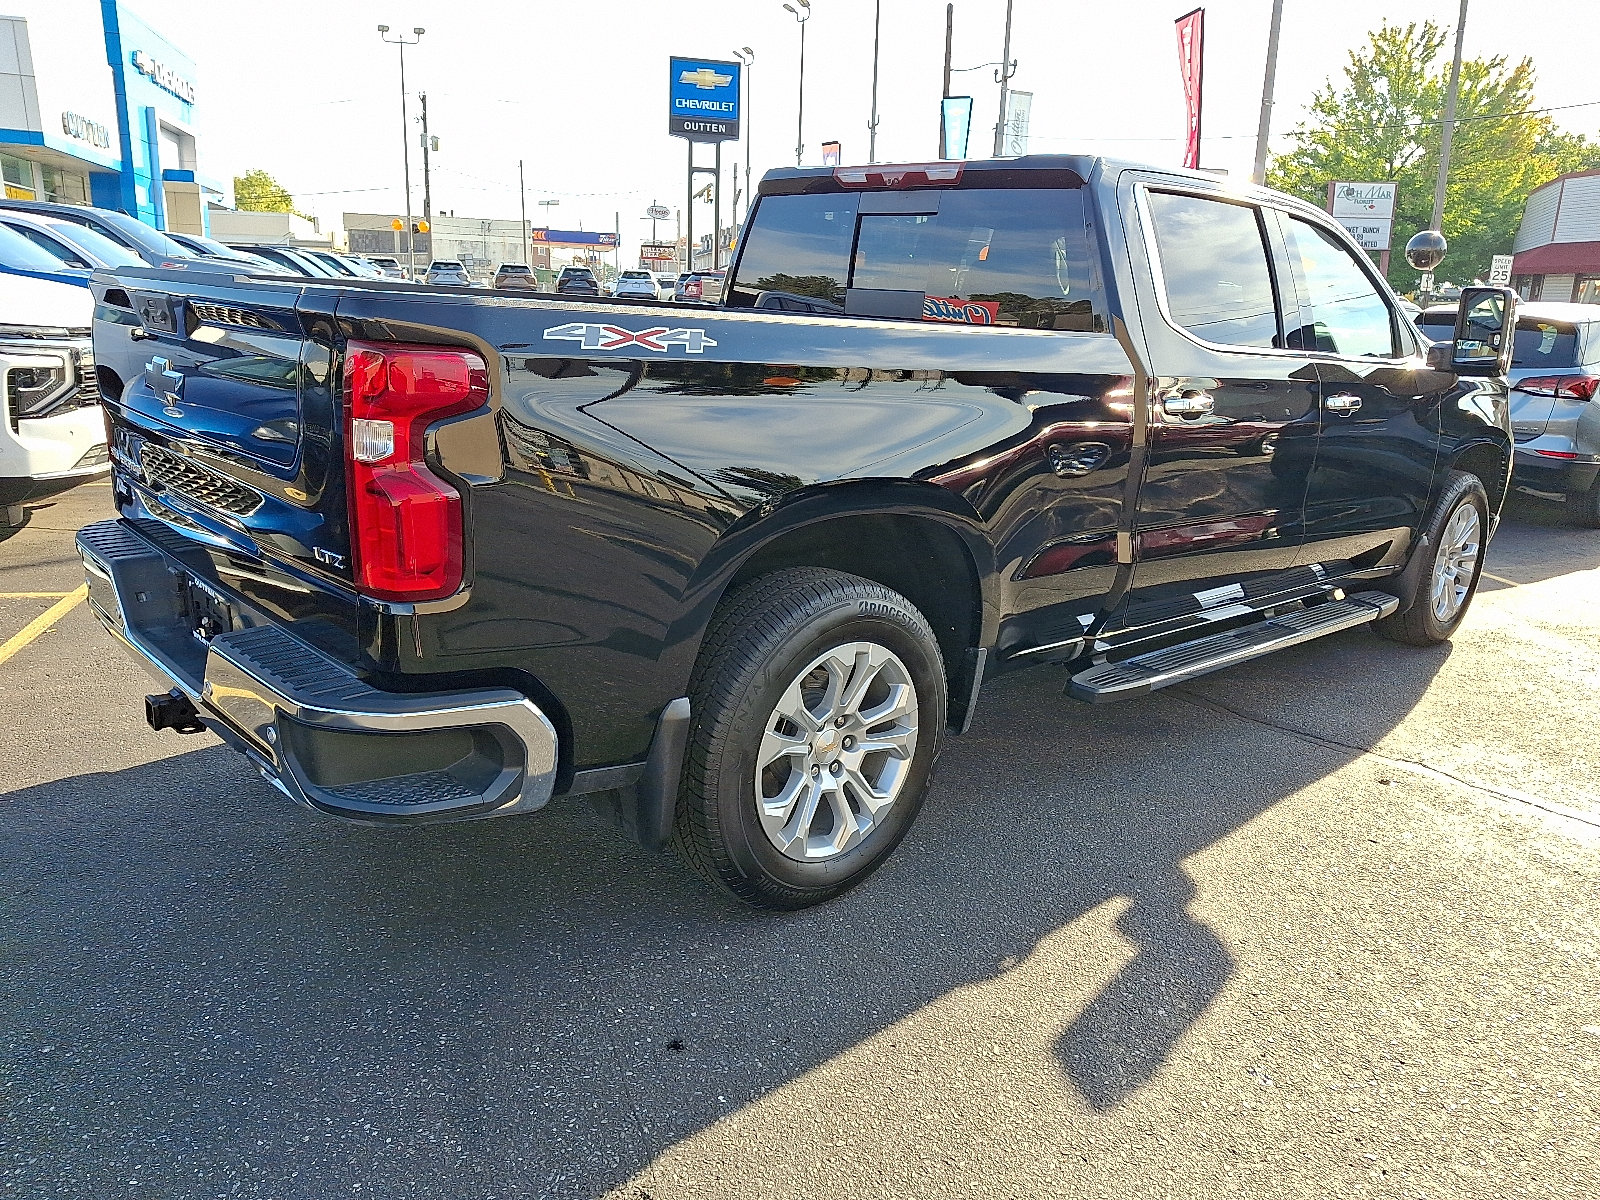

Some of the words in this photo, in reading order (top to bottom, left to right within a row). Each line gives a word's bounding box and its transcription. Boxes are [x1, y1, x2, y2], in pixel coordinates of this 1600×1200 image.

[675, 98, 735, 112] CHEVROLET
[683, 121, 726, 133] OUTTEN
[1362, 226, 1380, 234] BUNCH
[1492, 270, 1509, 281] 25
[312, 546, 346, 570] LTZ
[858, 600, 929, 642] BRIDGESTONE
